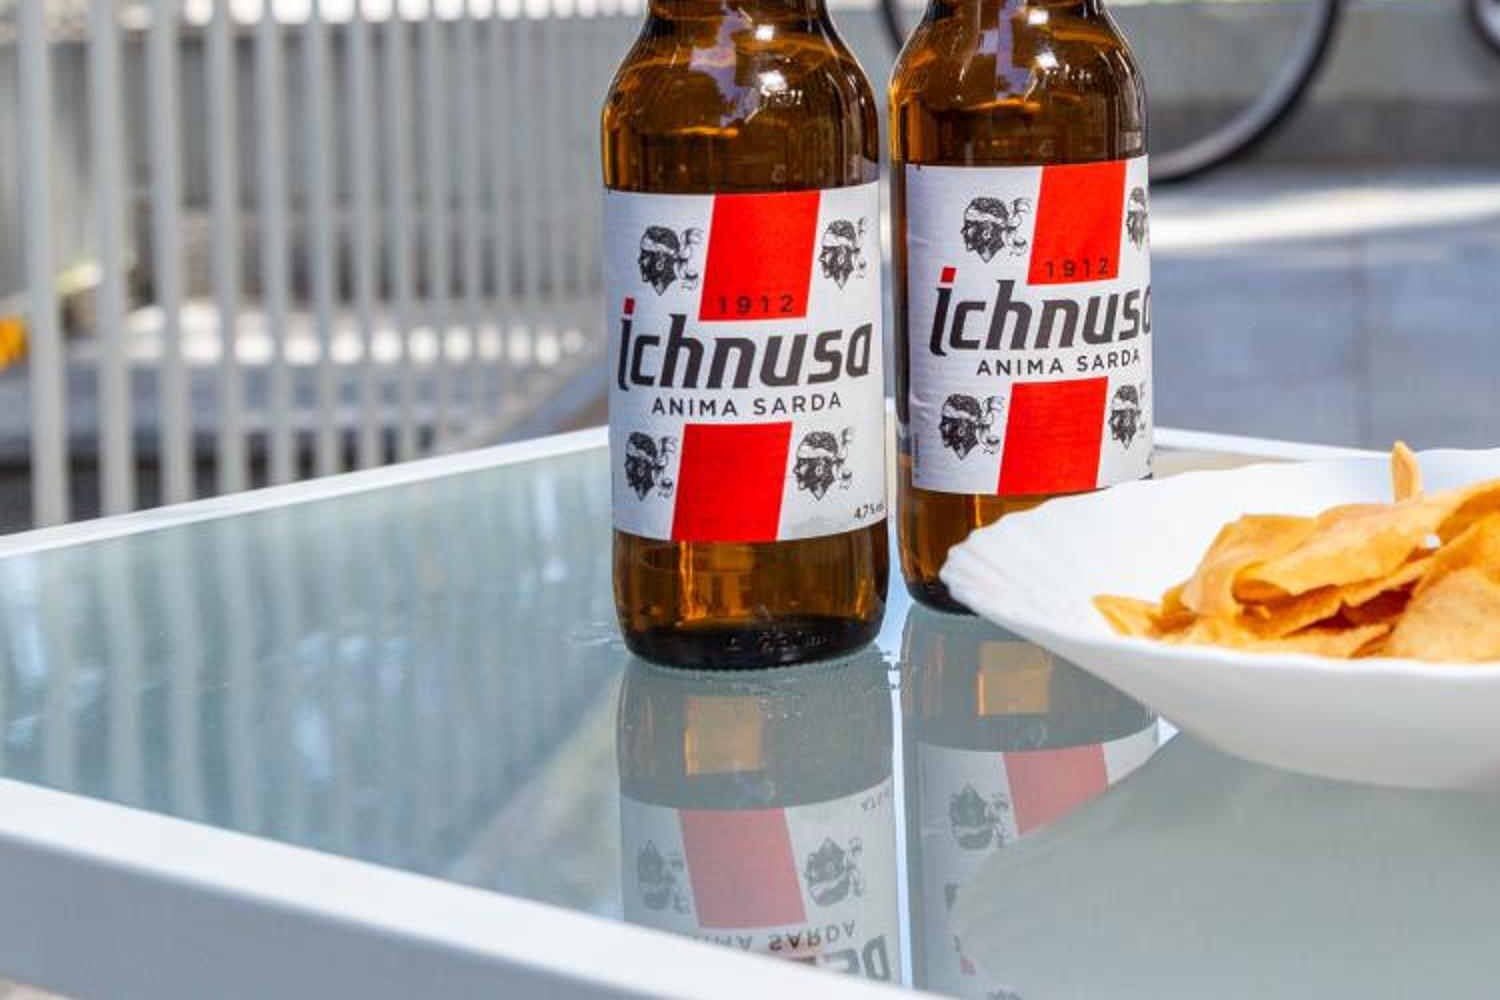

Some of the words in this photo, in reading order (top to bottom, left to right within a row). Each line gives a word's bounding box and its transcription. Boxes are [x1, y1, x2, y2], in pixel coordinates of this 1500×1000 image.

[1046, 258, 1109, 277] 1912
[718, 294, 795, 313] 1912
[617, 297, 873, 391] ichnusa
[976, 358, 1063, 377] ANIMA
[1076, 348, 1140, 373] SARDA
[651, 397, 738, 417] ANIMA
[752, 391, 842, 416] SARDA
